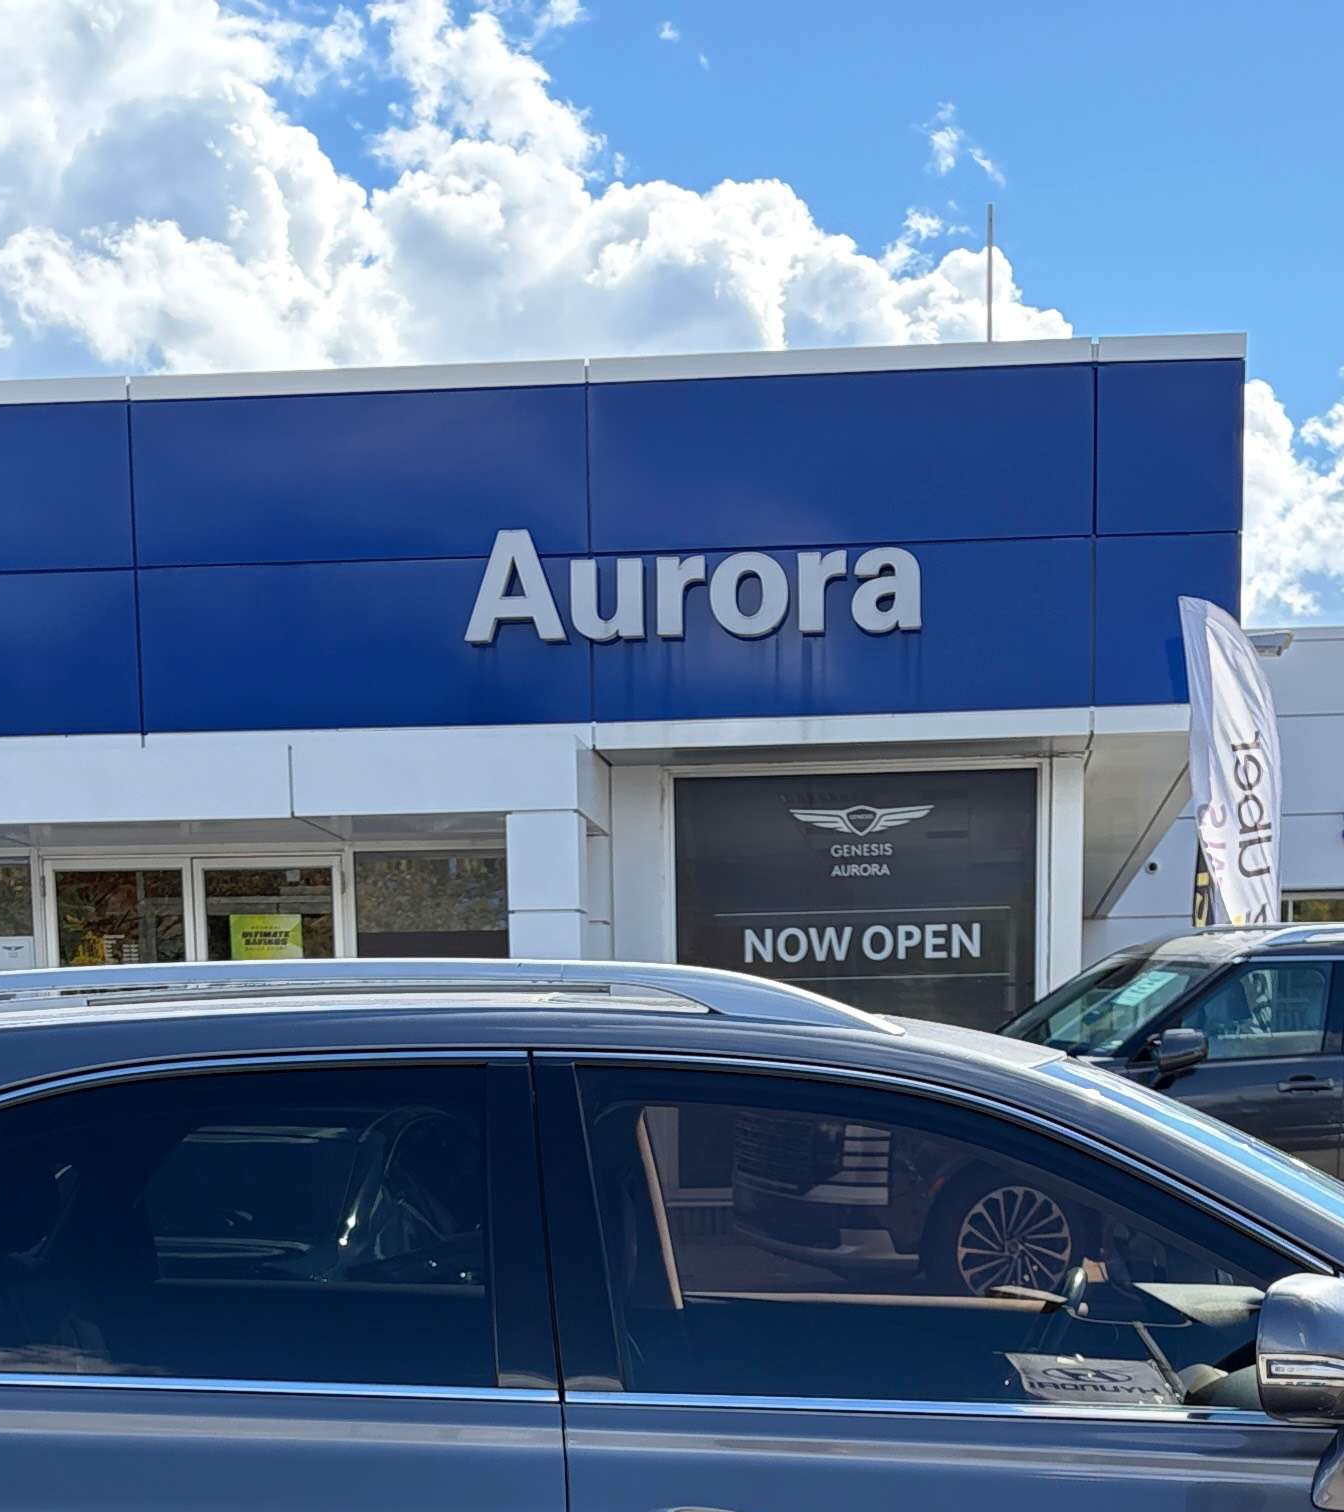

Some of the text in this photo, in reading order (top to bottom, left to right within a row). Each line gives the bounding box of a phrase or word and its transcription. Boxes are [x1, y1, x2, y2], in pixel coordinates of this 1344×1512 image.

[463, 528, 923, 645] Aurora
[830, 842, 893, 858] GENESIS
[831, 863, 890, 877] AURORA
[744, 922, 982, 963] NOW OPEN
